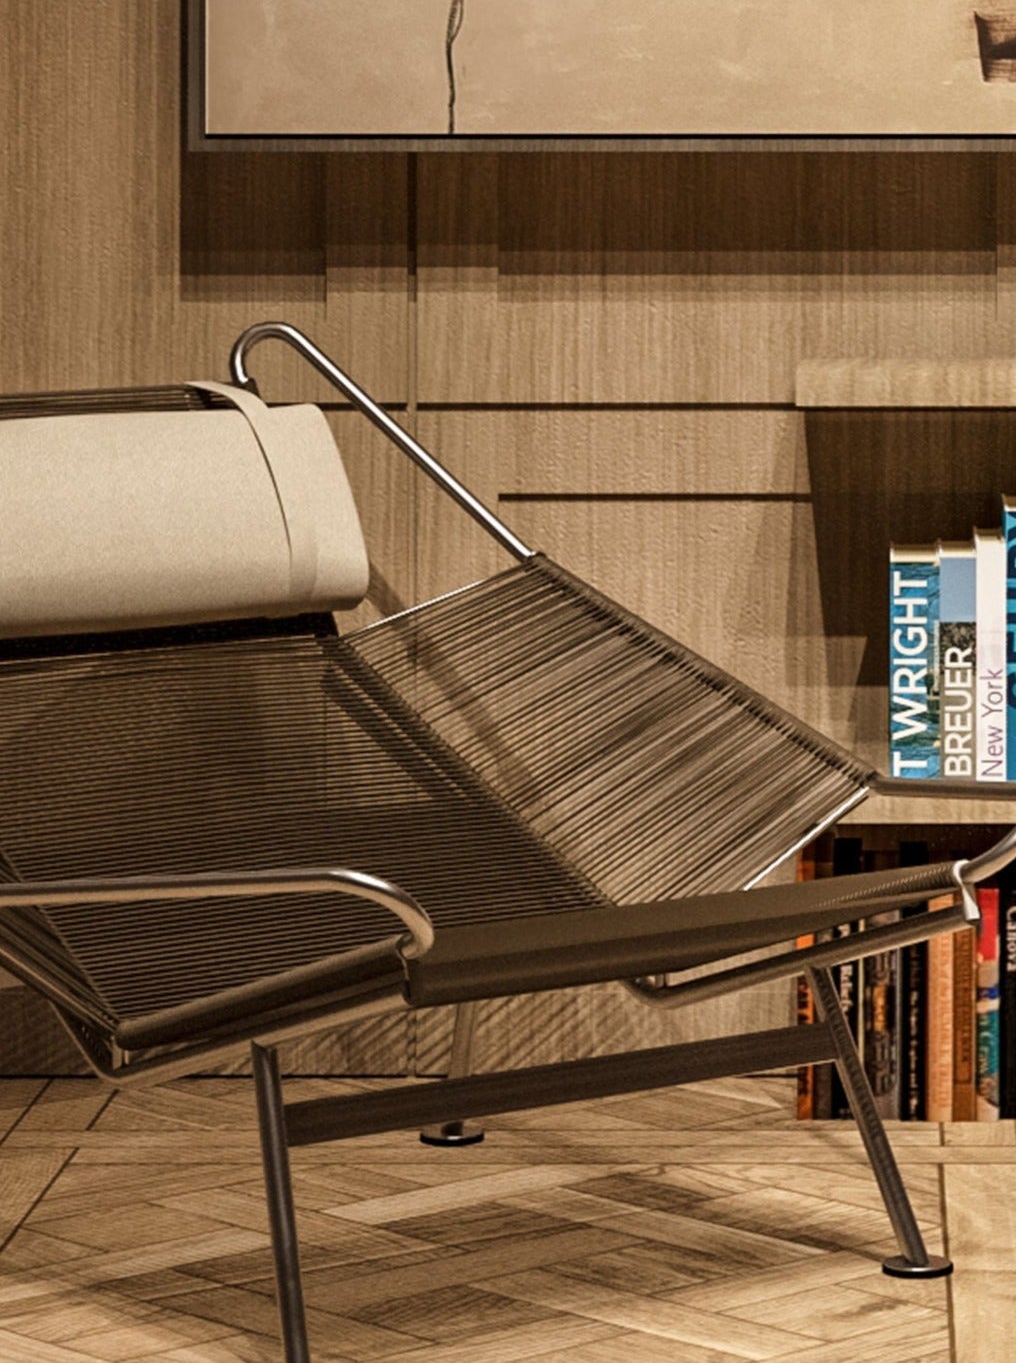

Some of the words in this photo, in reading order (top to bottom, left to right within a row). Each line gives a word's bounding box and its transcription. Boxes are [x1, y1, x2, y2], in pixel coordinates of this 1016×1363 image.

[893, 571, 928, 740] WRIGHT
[944, 647, 972, 776] BREUER
[979, 669, 1003, 717] York
[893, 751, 928, 777] T
[981, 726, 1003, 777] New
